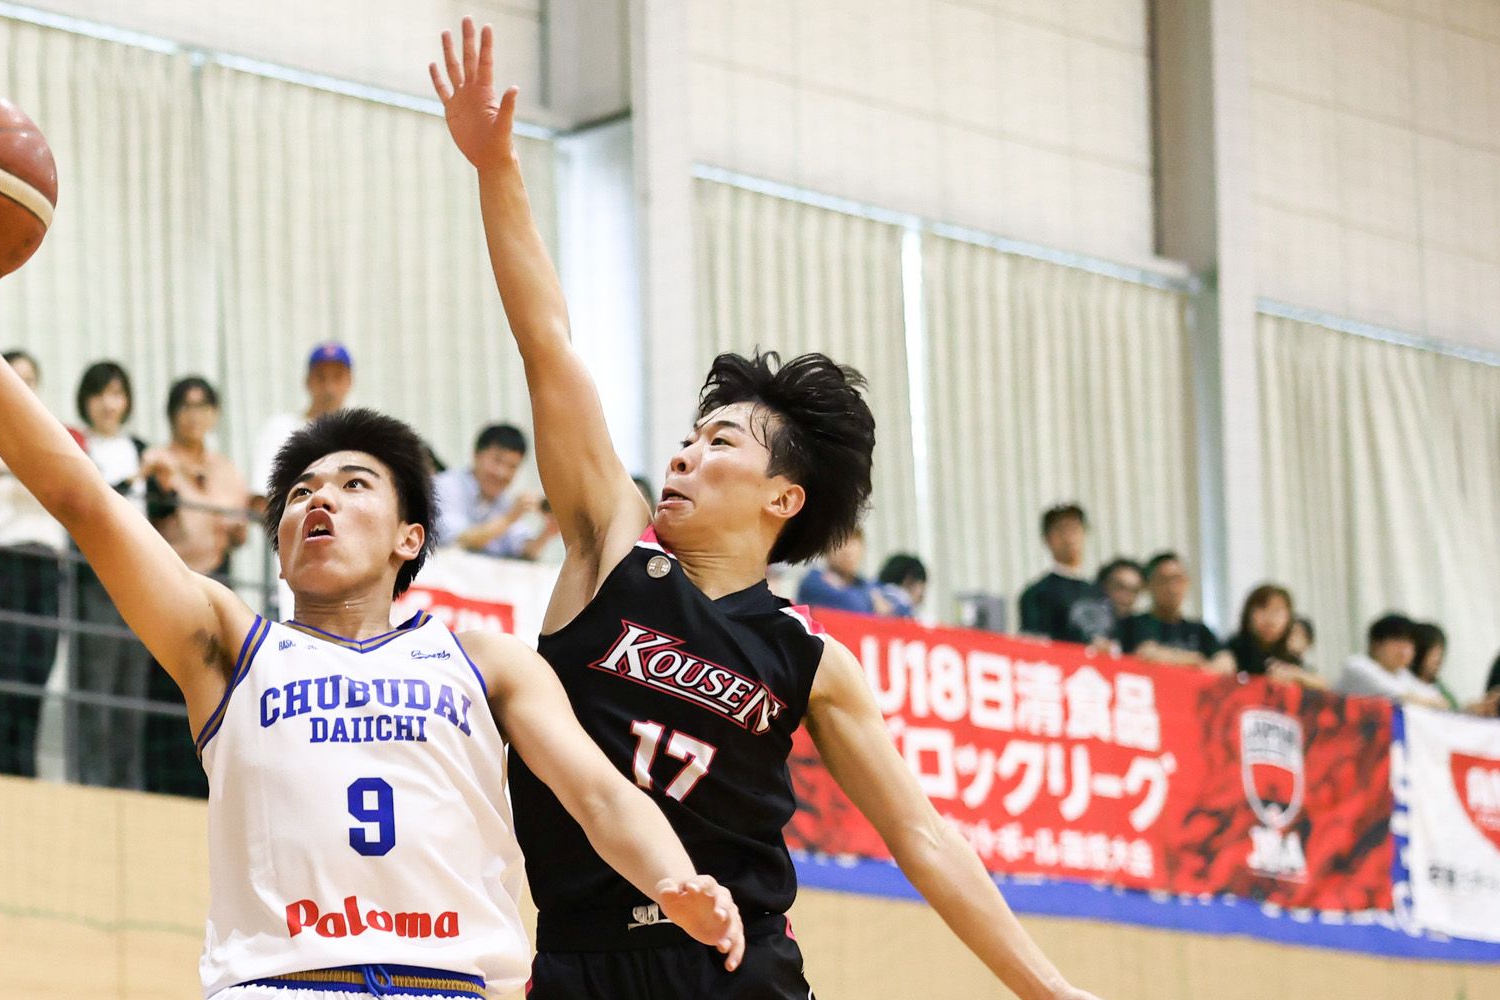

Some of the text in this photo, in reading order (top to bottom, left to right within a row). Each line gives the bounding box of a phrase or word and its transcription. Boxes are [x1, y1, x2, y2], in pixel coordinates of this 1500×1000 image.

[260, 674, 472, 737] CHUBUDAI
[591, 621, 785, 734] KOUSEN
[860, 635, 1160, 751] U18日清食品
[310, 714, 428, 743] DAIICHI
[630, 719, 718, 802] 17
[884, 714, 1177, 832] ロックリーグ
[347, 777, 396, 856] 9
[286, 895, 459, 938] Paloma
